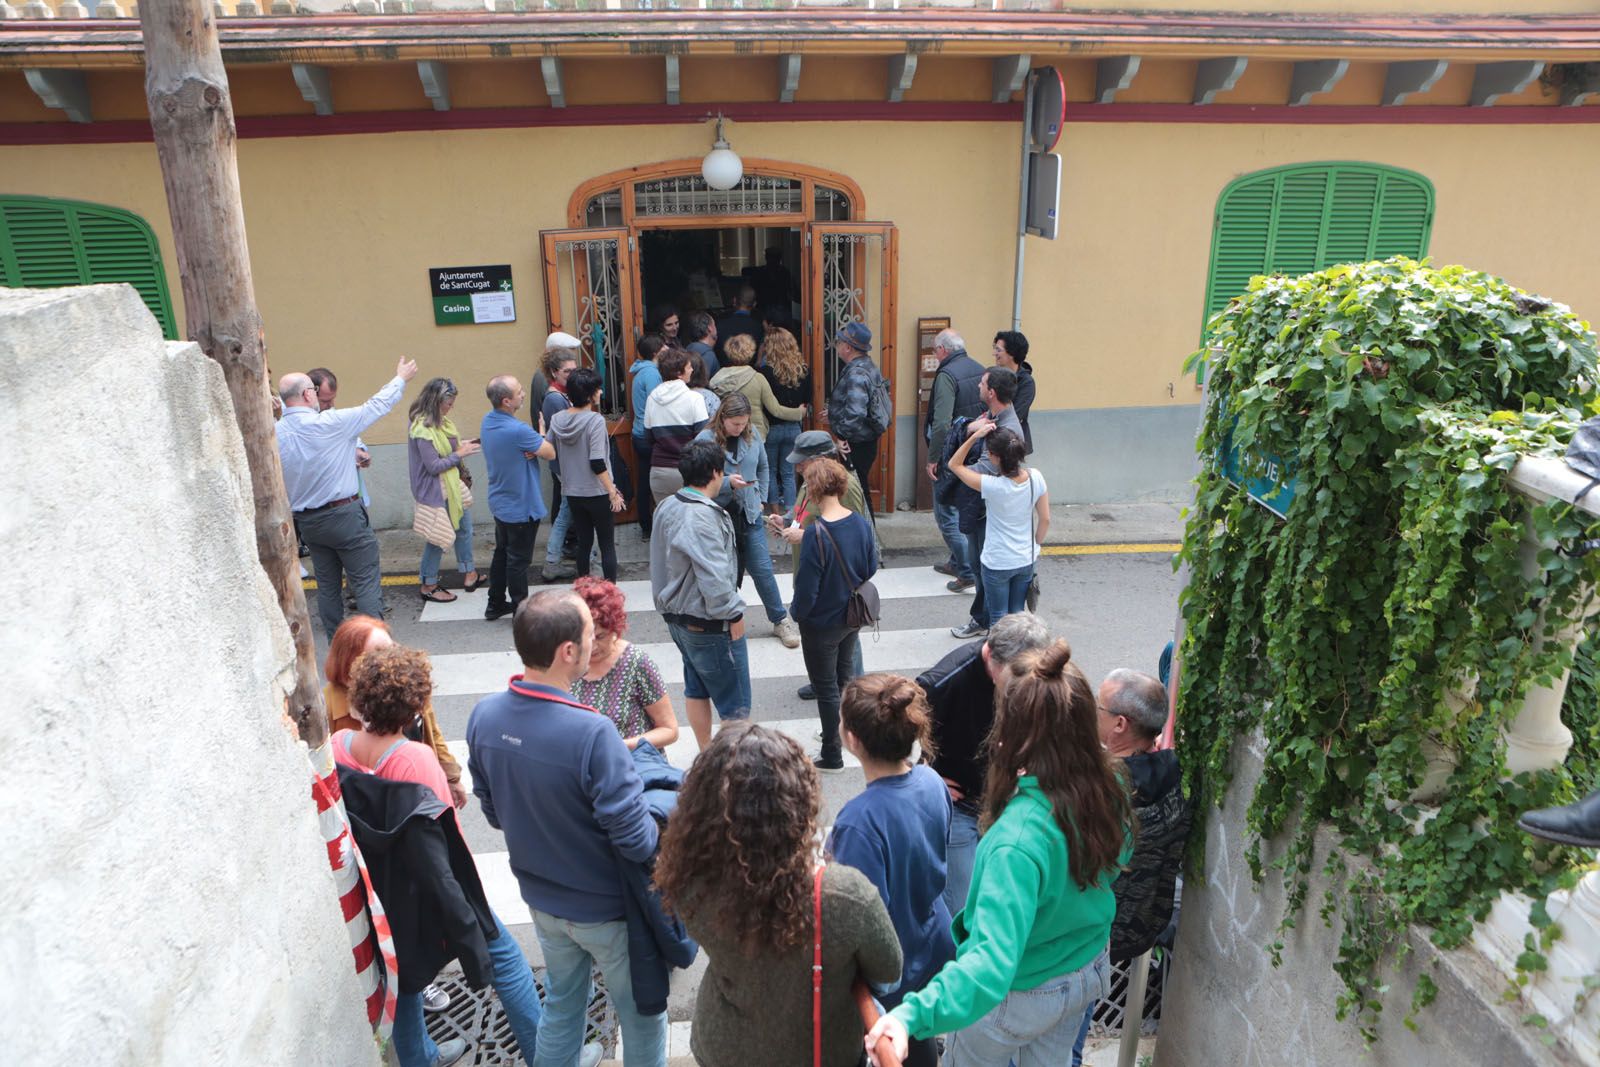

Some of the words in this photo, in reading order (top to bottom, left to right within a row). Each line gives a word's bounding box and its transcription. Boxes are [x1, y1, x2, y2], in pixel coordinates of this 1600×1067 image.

[439, 271, 484, 282] Ajuntament
[440, 282, 450, 290] de
[442, 304, 471, 313] Casino
